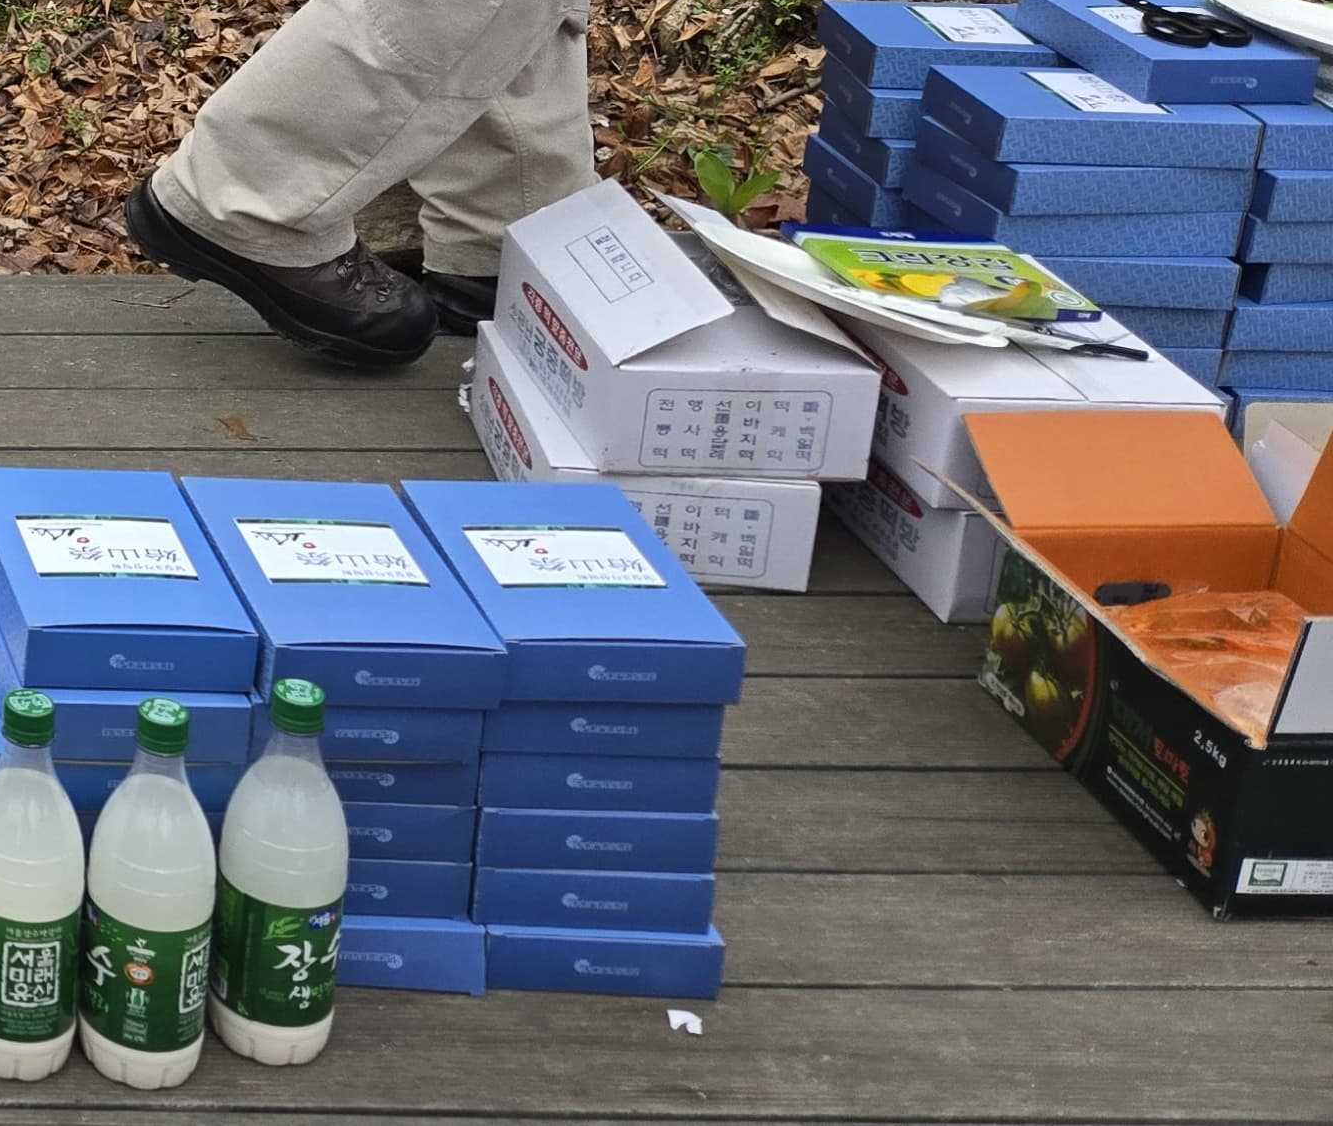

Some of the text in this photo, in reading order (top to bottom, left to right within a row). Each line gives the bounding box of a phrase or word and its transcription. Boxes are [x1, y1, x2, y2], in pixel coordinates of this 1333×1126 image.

[738, 399, 763, 461] 이바지떡
[1193, 729, 1227, 769] 2.5kg
[10, 948, 55, 967] 서울
[9, 966, 54, 983] 미래
[8, 982, 54, 1002] 유산
